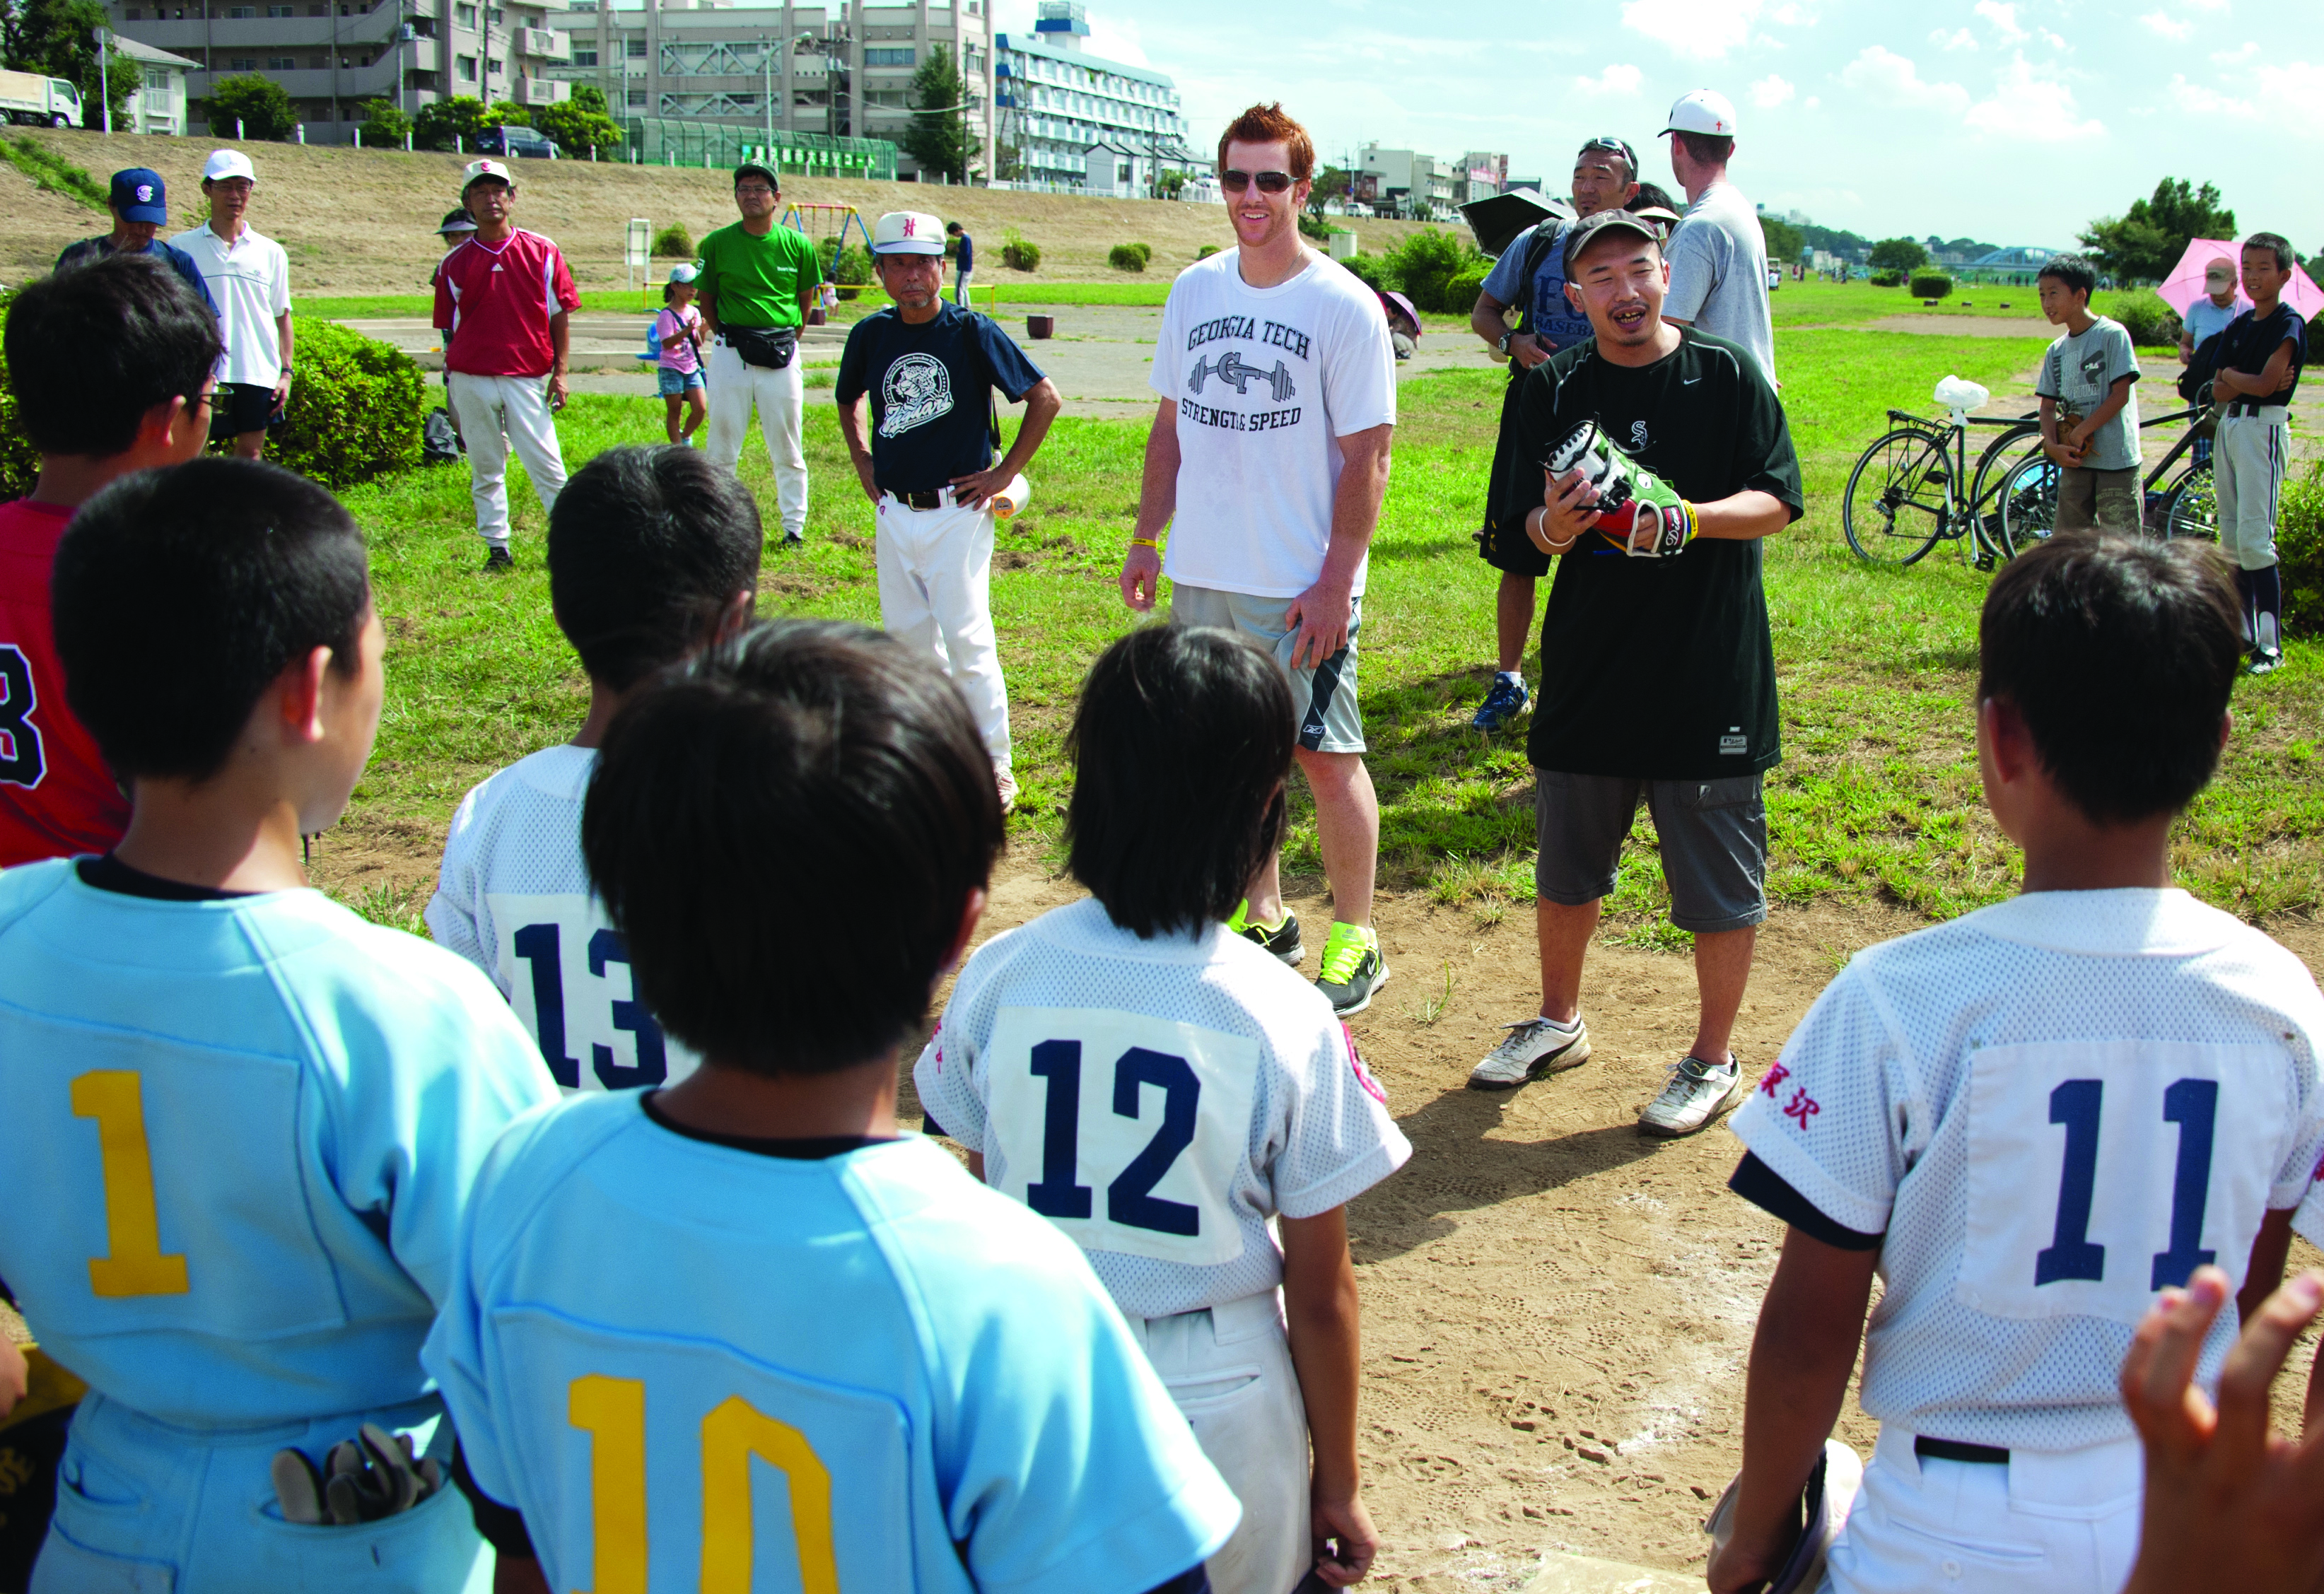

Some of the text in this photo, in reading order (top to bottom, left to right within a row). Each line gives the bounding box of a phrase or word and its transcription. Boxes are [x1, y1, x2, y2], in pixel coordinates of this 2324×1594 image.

[1187, 315, 1312, 362] GEORGIA TECH
[1535, 316, 1596, 336] BASEB
[880, 394, 952, 434] Jaguars
[1249, 407, 1301, 431] SPEED
[514, 922, 667, 1091] 13
[70, 1068, 191, 1299] 1
[1027, 1039, 1201, 1236] 12
[2033, 1077, 2219, 1292] 11
[568, 1372, 841, 1594] 10
